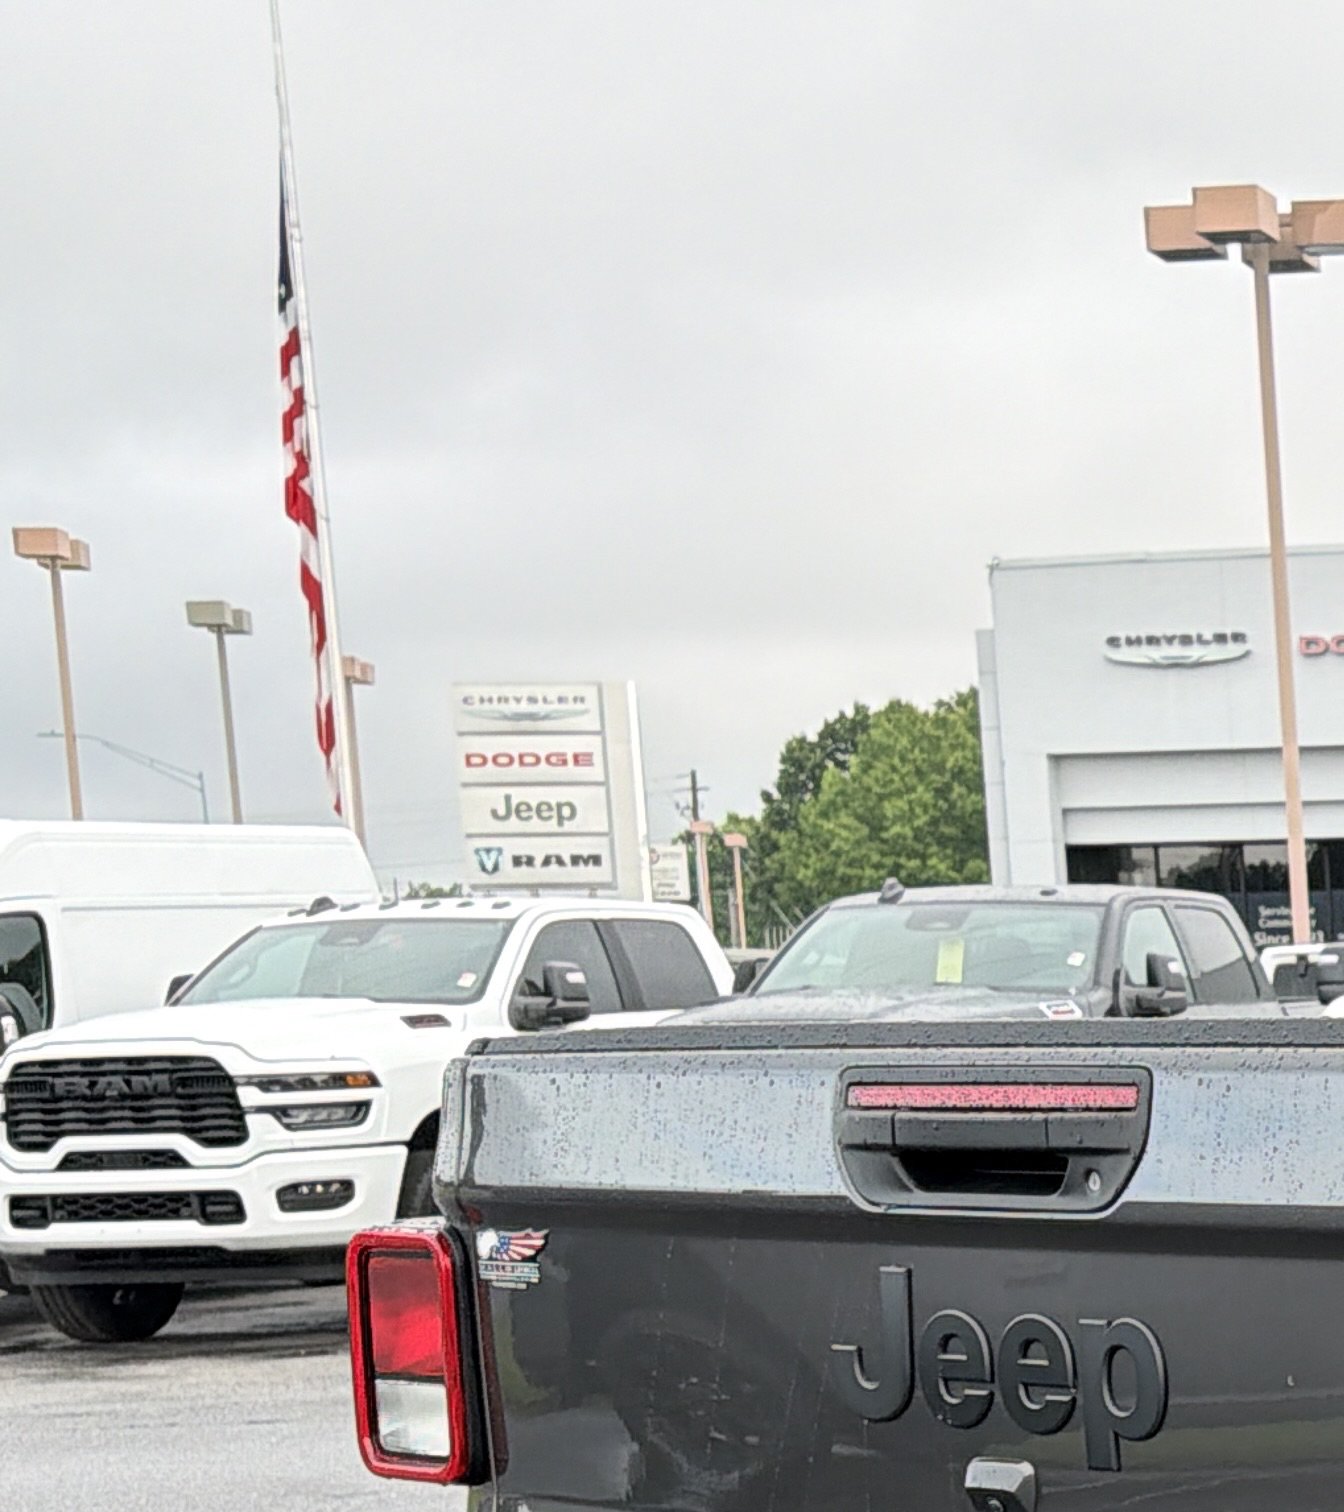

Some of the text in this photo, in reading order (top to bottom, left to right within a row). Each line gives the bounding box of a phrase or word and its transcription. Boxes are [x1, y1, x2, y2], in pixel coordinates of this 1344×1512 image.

[1106, 632, 1247, 648] CHRYSLER
[462, 694, 587, 706] CHRYSLER
[464, 751, 595, 768] DODGE
[490, 793, 577, 827] Jeep
[511, 853, 603, 869] RAM
[53, 1073, 171, 1097] RAM
[830, 1264, 1169, 1472] Jeep
